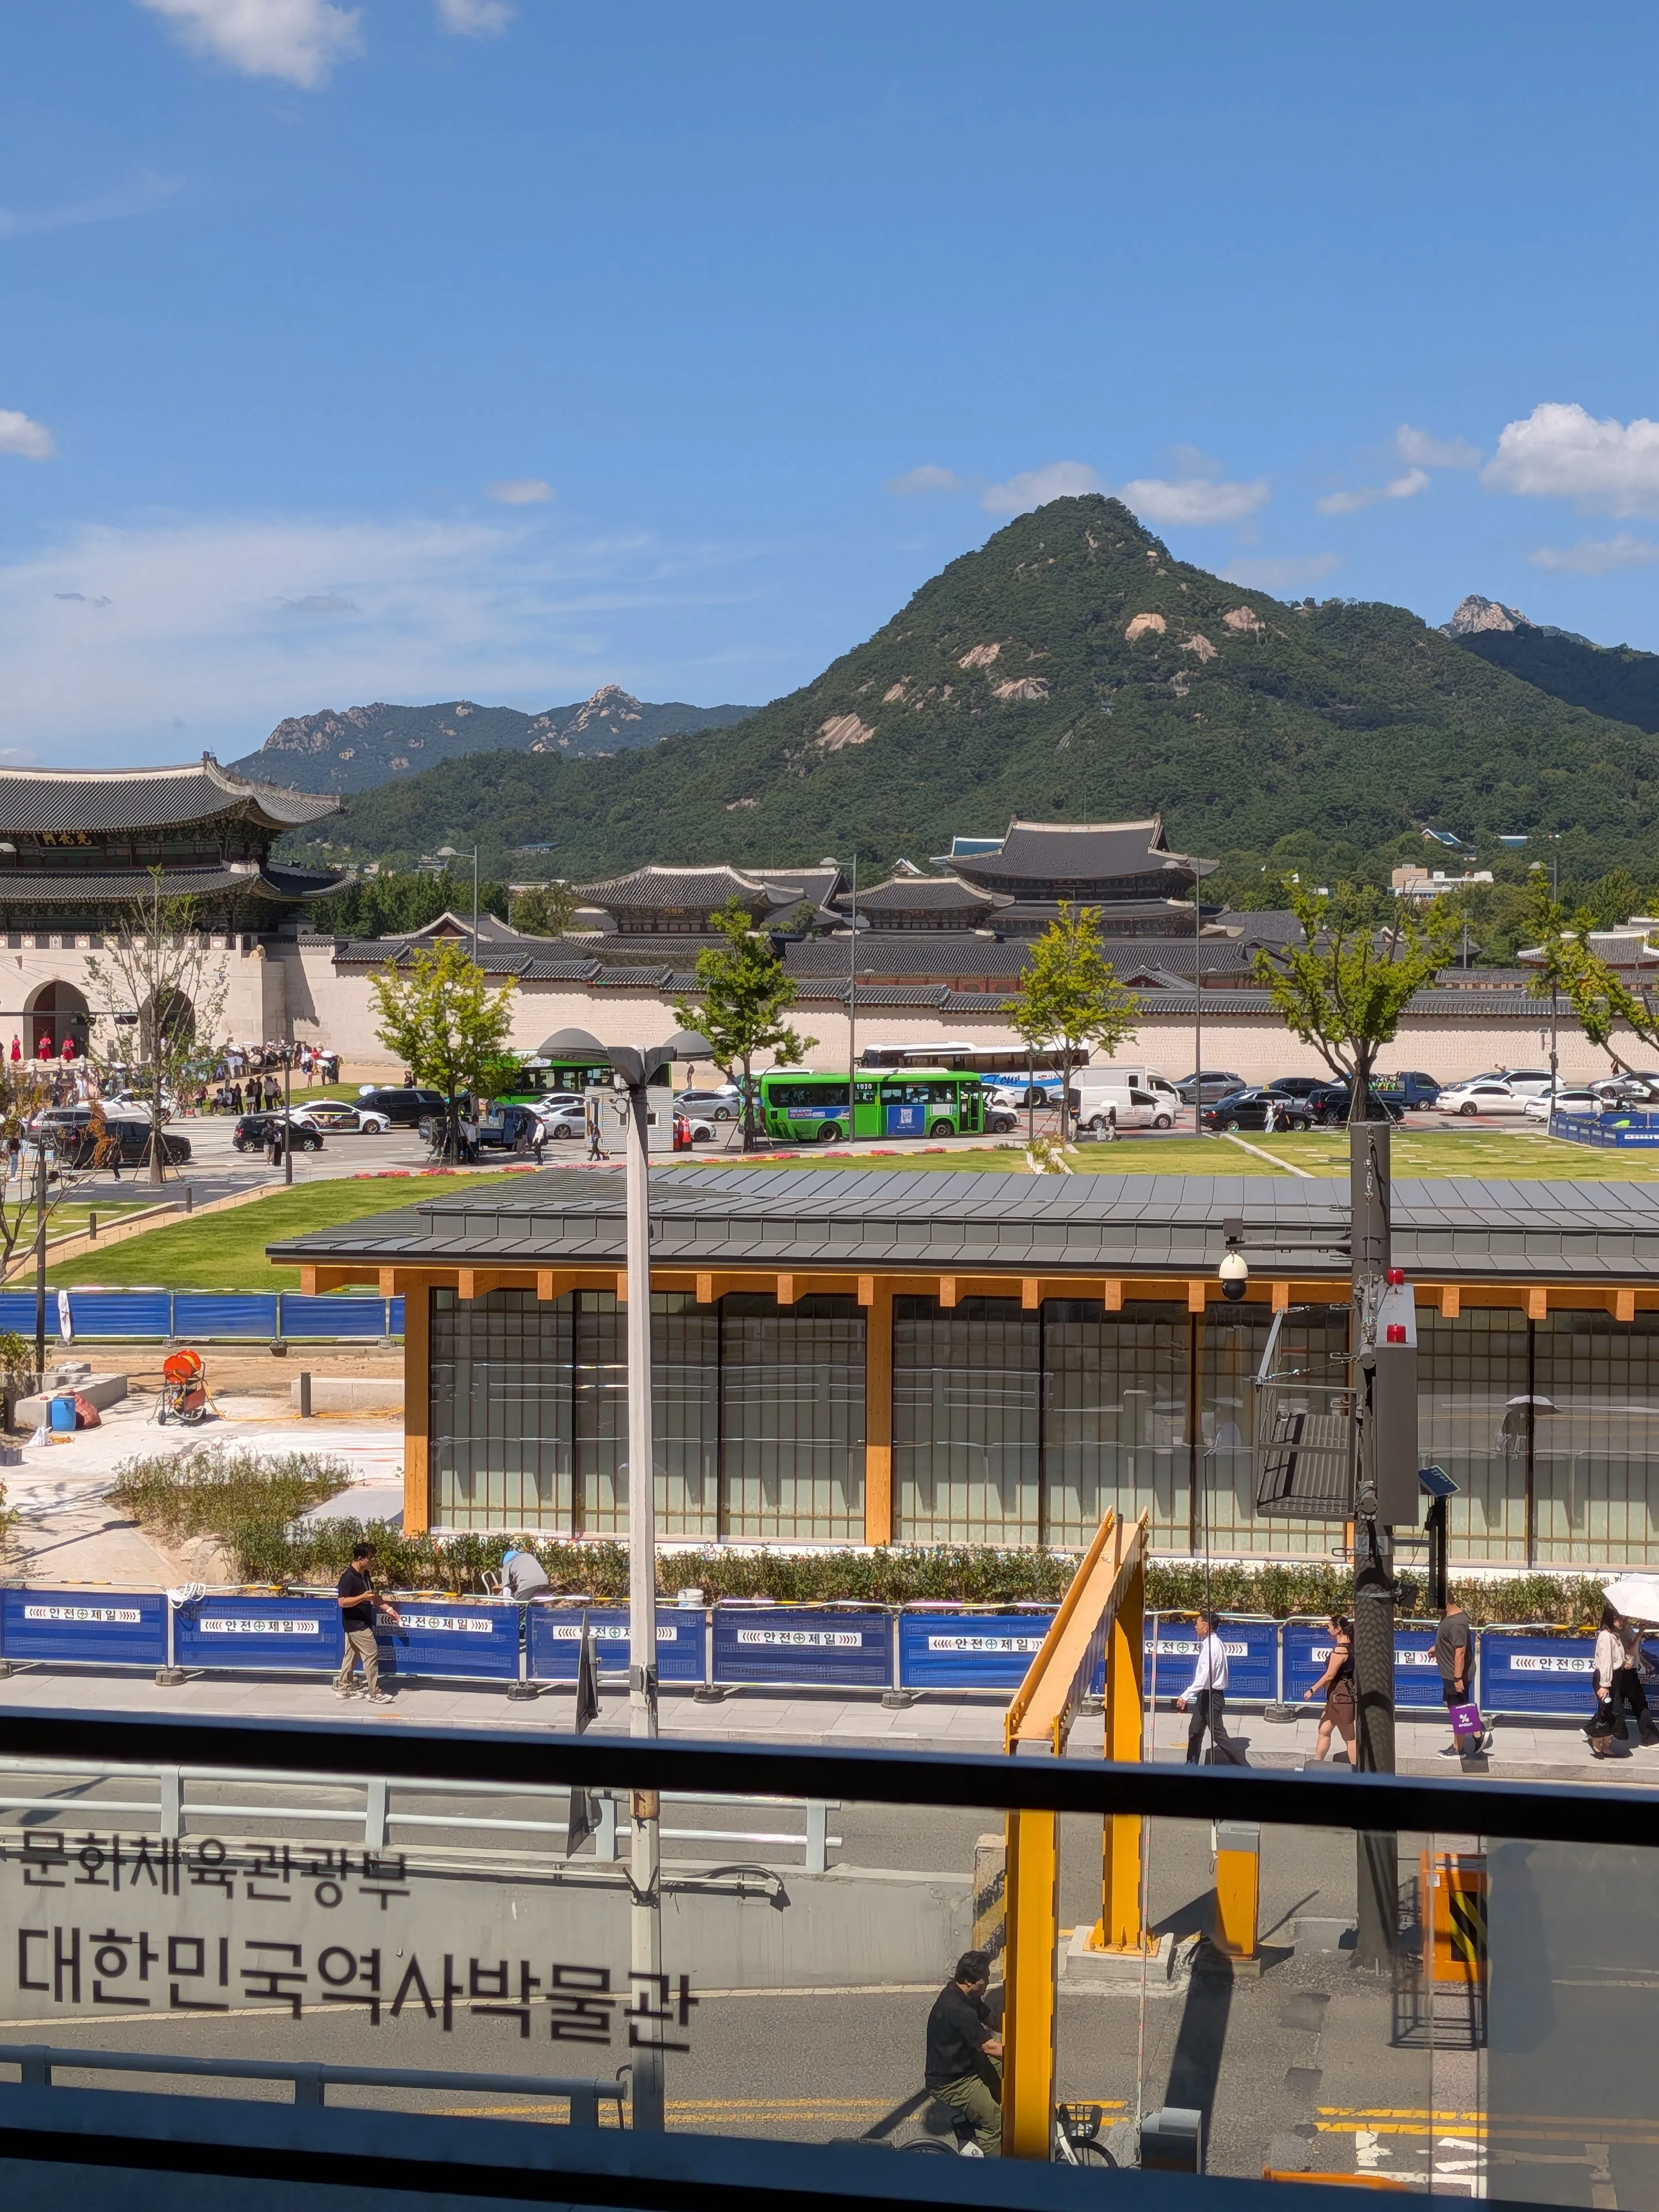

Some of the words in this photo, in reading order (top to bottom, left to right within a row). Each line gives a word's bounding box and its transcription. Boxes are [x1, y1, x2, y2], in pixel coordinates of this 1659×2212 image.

[49, 1608, 74, 1619] 안전
[91, 1609, 116, 1621] 제일
[226, 1620, 251, 1632] 안전
[268, 1621, 294, 1632] 제일
[442, 1618, 468, 1631] 제일
[764, 1632, 791, 1644] 안전
[808, 1633, 836, 1645] 제일
[956, 1639, 983, 1650] 안전
[1000, 1639, 1028, 1651] 제일
[1539, 1658, 1569, 1671] 안전
[19, 1830, 410, 1911] 문화체육관광부
[18, 1926, 700, 2052] 대한민국역사박물관
